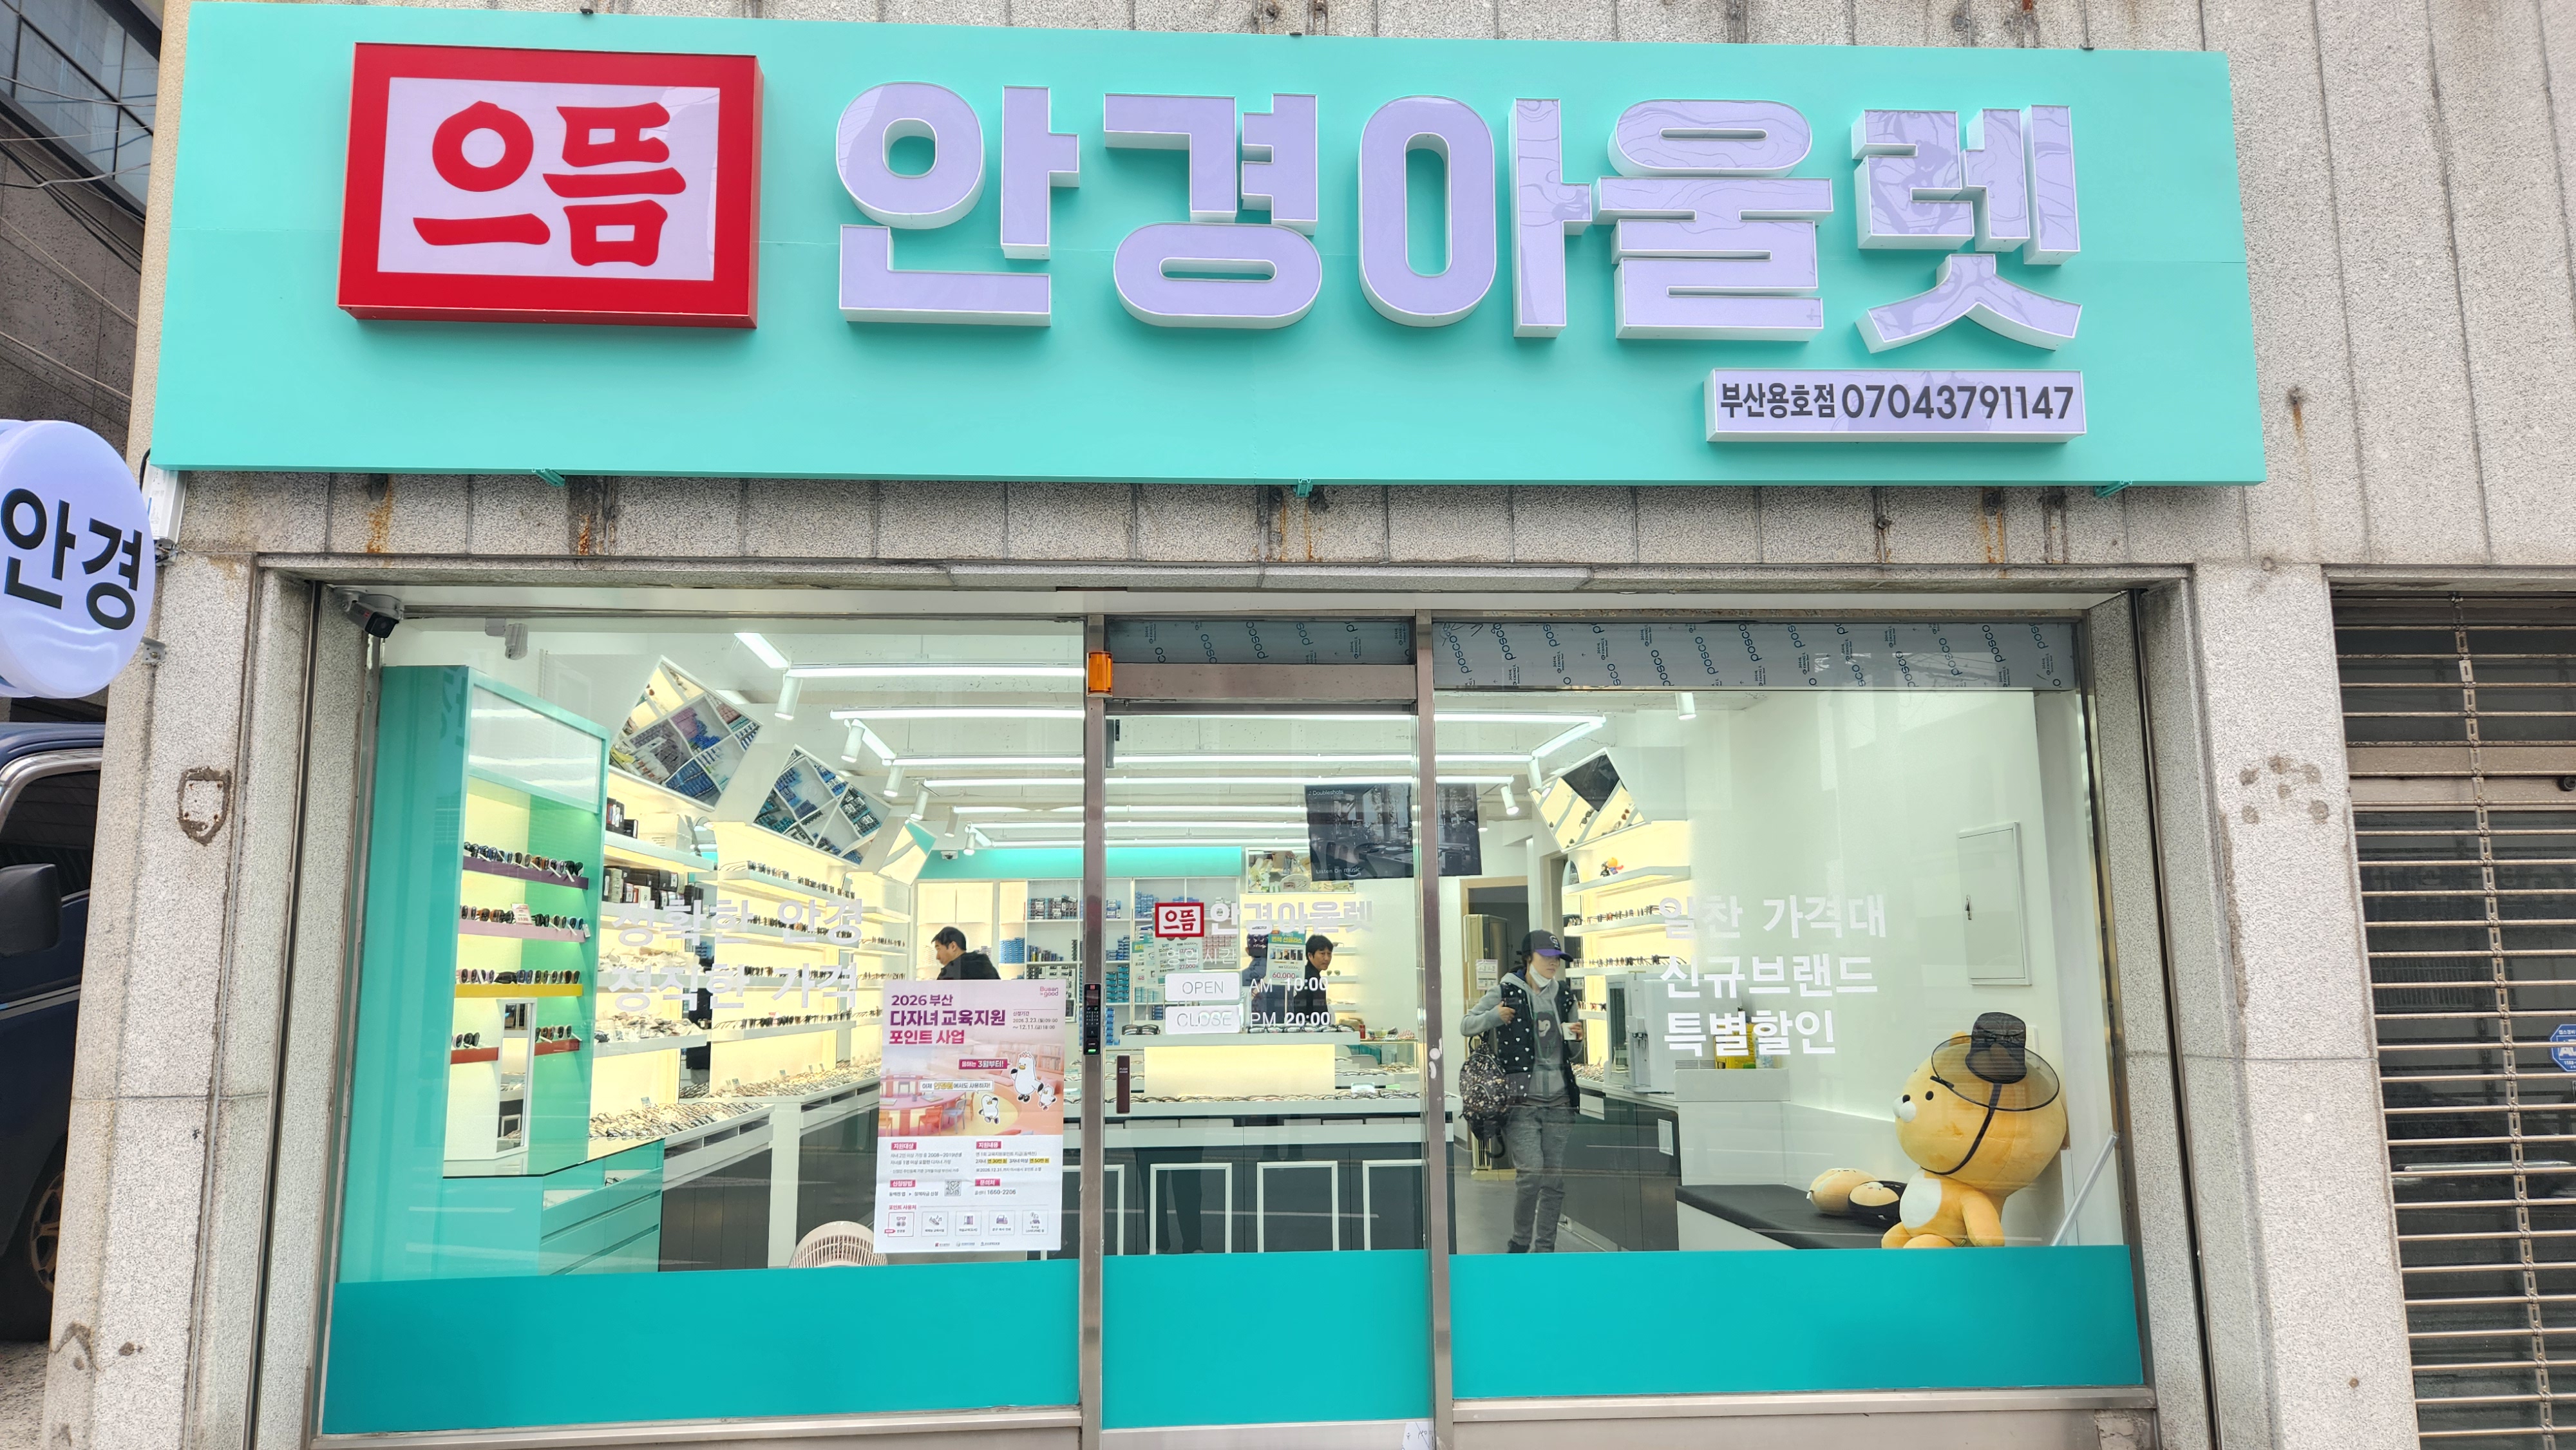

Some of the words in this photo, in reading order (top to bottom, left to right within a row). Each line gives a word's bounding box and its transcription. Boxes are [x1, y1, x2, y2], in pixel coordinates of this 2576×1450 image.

[412, 100, 687, 267] 으뜸
[835, 80, 2082, 354] 안경아울렛
[1720, 382, 1836, 419] 부산용호점
[1842, 383, 2074, 420] 07043791147
[1, 487, 143, 630] 안경
[1201, 634, 1217, 663] osco
[1296, 622, 1314, 646] pos
[1543, 624, 1561, 647] pos
[1739, 623, 1763, 662] posco
[1788, 625, 1806, 648] pos
[1982, 625, 2006, 663] posco
[1450, 635, 1472, 673] posco
[1695, 636, 1719, 675] posco
[1938, 637, 1963, 676] posco
[611, 899, 754, 946] 정확한
[777, 898, 863, 944] 안경
[1163, 909, 1197, 932] 으뜸
[1210, 900, 1373, 935] 안경아울렛
[1763, 894, 1886, 938] 가격대
[1166, 947, 1237, 966] 영업시간
[1660, 953, 1877, 998] 신규브랜드
[607, 963, 750, 1012] 정직한
[772, 963, 858, 1009] 가격
[891, 995, 927, 1006] 2026
[929, 994, 953, 1006] 부산
[1182, 981, 1224, 995] OPEN
[1249, 979, 1273, 993] AM
[1285, 977, 1329, 992] 10:00
[890, 1010, 938, 1026] 다자녀
[941, 1009, 1006, 1026] 교육지원
[1177, 1012, 1233, 1027] CLOSE
[1251, 1012, 1276, 1027] PM
[1285, 1012, 1331, 1027] 20:00
[1664, 1010, 1835, 1057] 특별할인
[889, 1030, 933, 1045] 포인트
[936, 1030, 965, 1044] 사업
